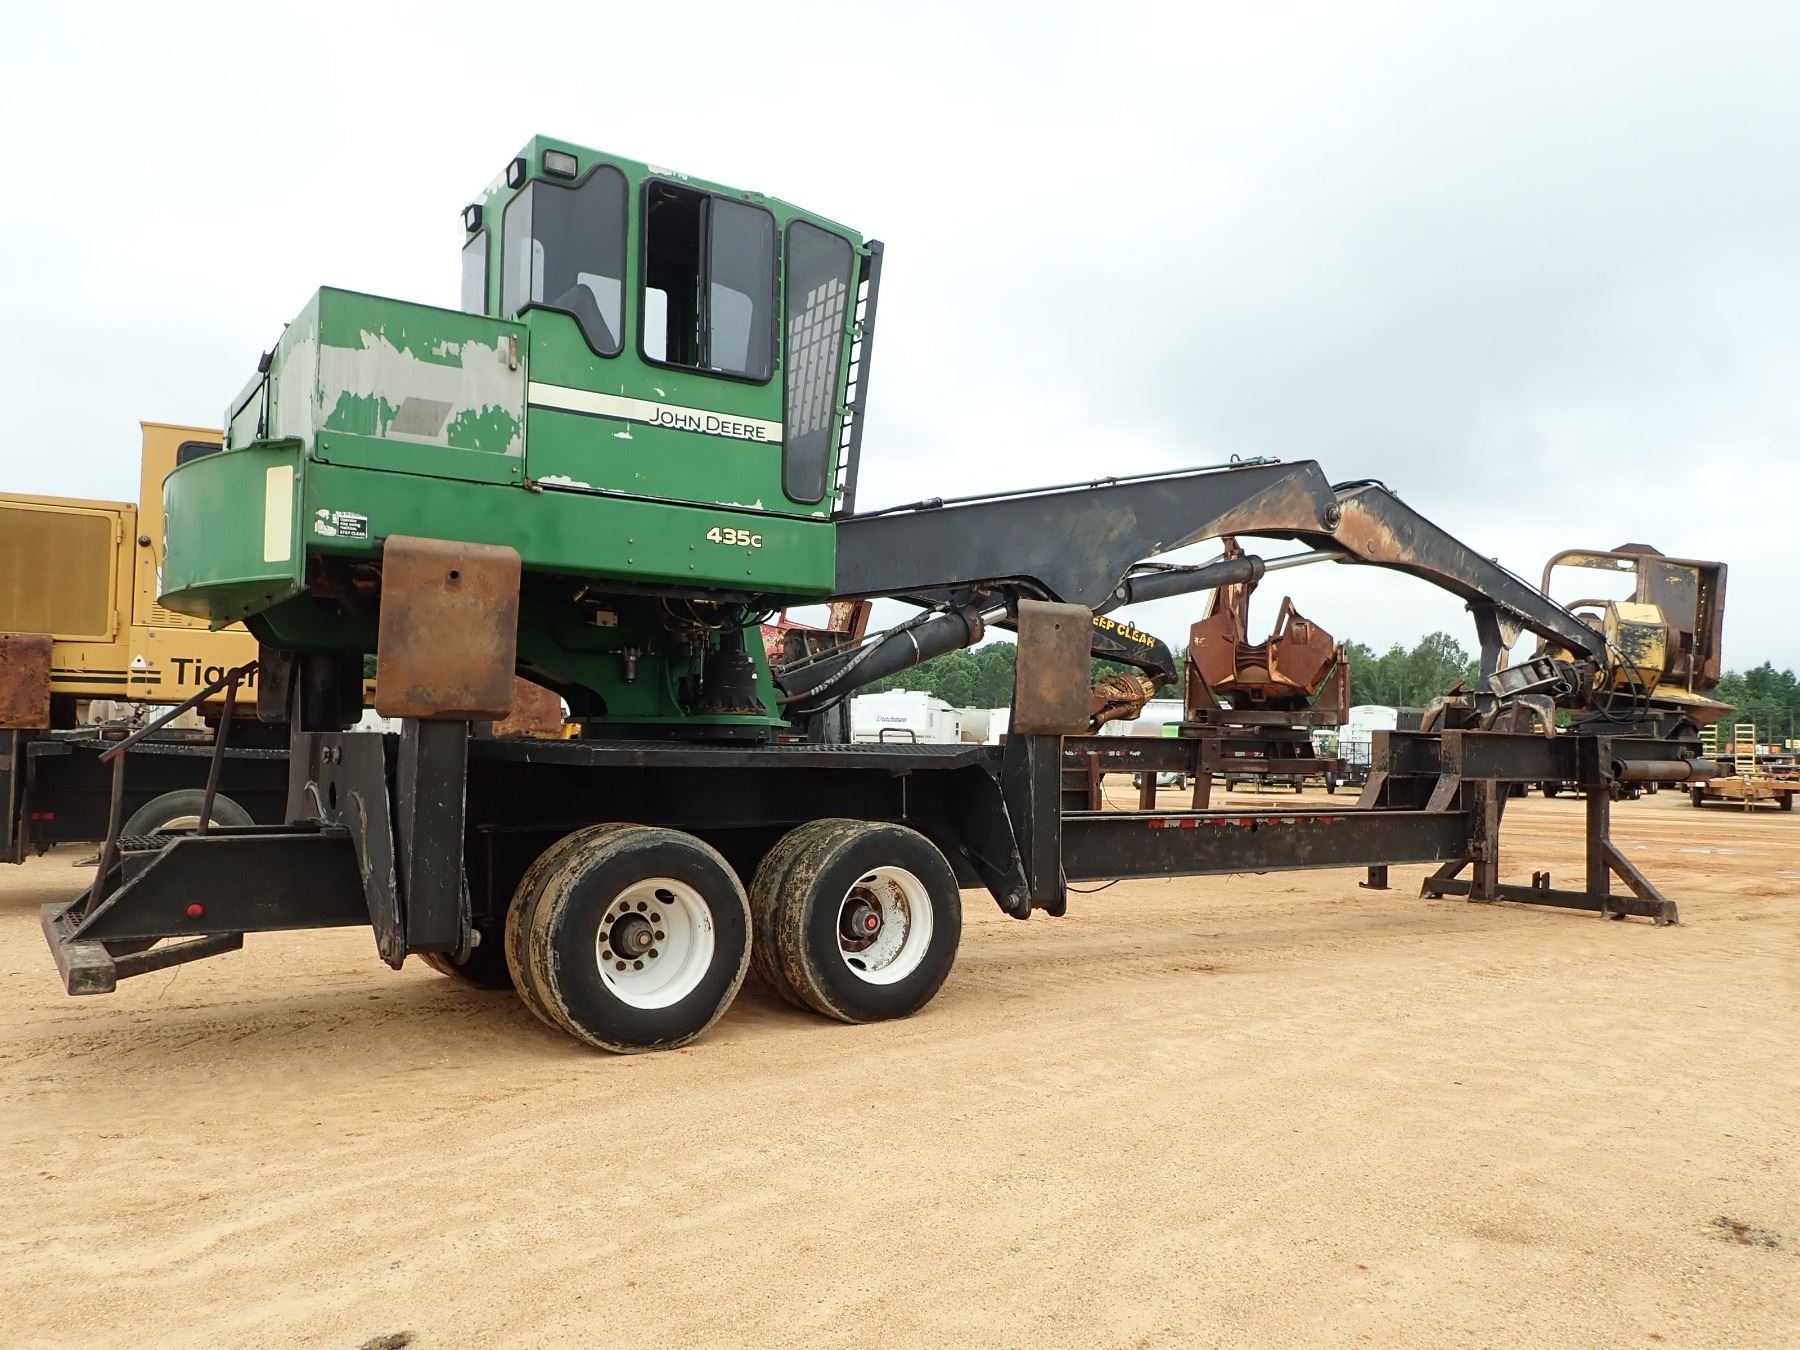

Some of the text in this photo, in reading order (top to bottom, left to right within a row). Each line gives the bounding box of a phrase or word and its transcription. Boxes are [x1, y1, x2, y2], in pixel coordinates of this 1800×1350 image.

[649, 407, 766, 439] JOHN DEERE
[706, 527, 762, 548] 435C
[1092, 616, 1156, 648] EEP CLEAR
